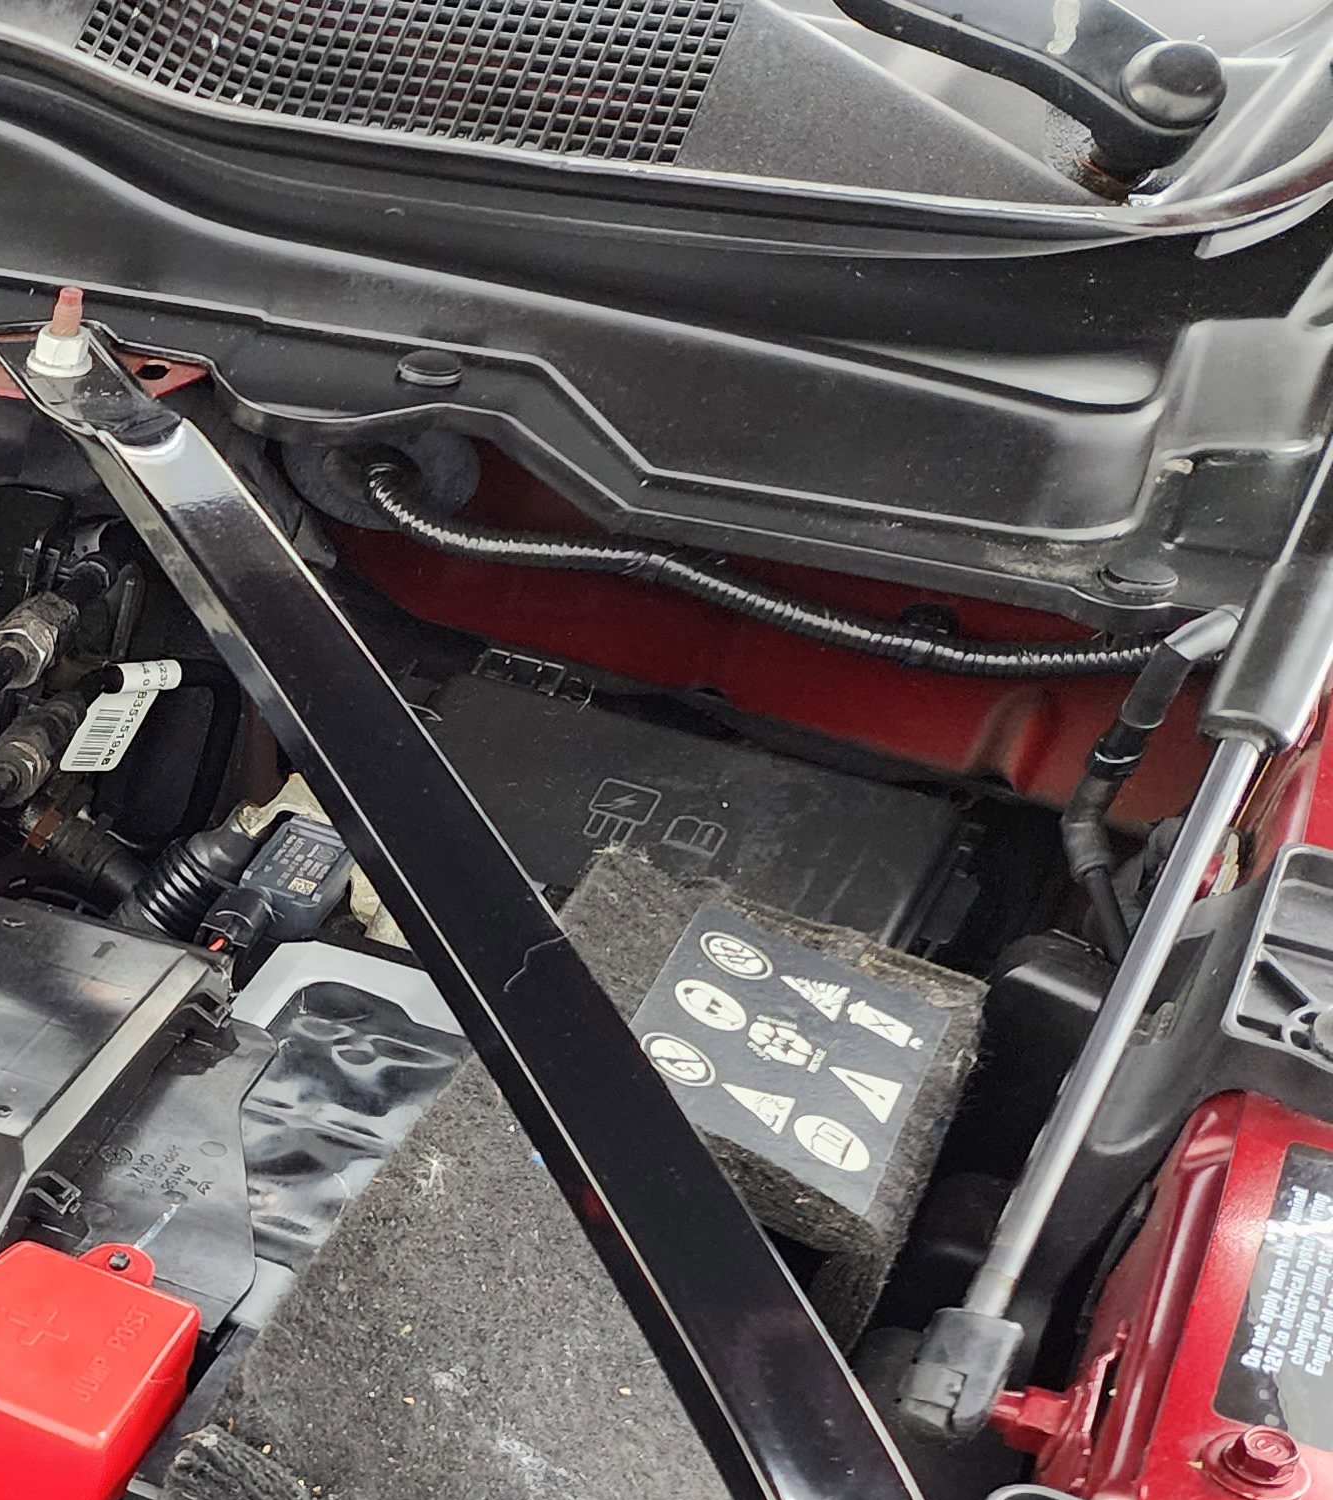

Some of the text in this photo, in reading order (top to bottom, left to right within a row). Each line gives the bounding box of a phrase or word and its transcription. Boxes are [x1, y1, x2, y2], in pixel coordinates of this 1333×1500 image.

[1269, 1257, 1290, 1290] more
[1307, 1264, 1331, 1298] jump
[1259, 1289, 1284, 1325] apply
[1277, 1269, 1307, 1331] electrical
[1306, 1294, 1320, 1312] or
[1251, 1324, 1270, 1348] not
[1272, 1325, 1291, 1347] to
[1288, 1309, 1321, 1366] charging
[73, 1305, 151, 1403] JUMP POST
[1241, 1345, 1263, 1369] Do
[1261, 1346, 1285, 1375] 12V
